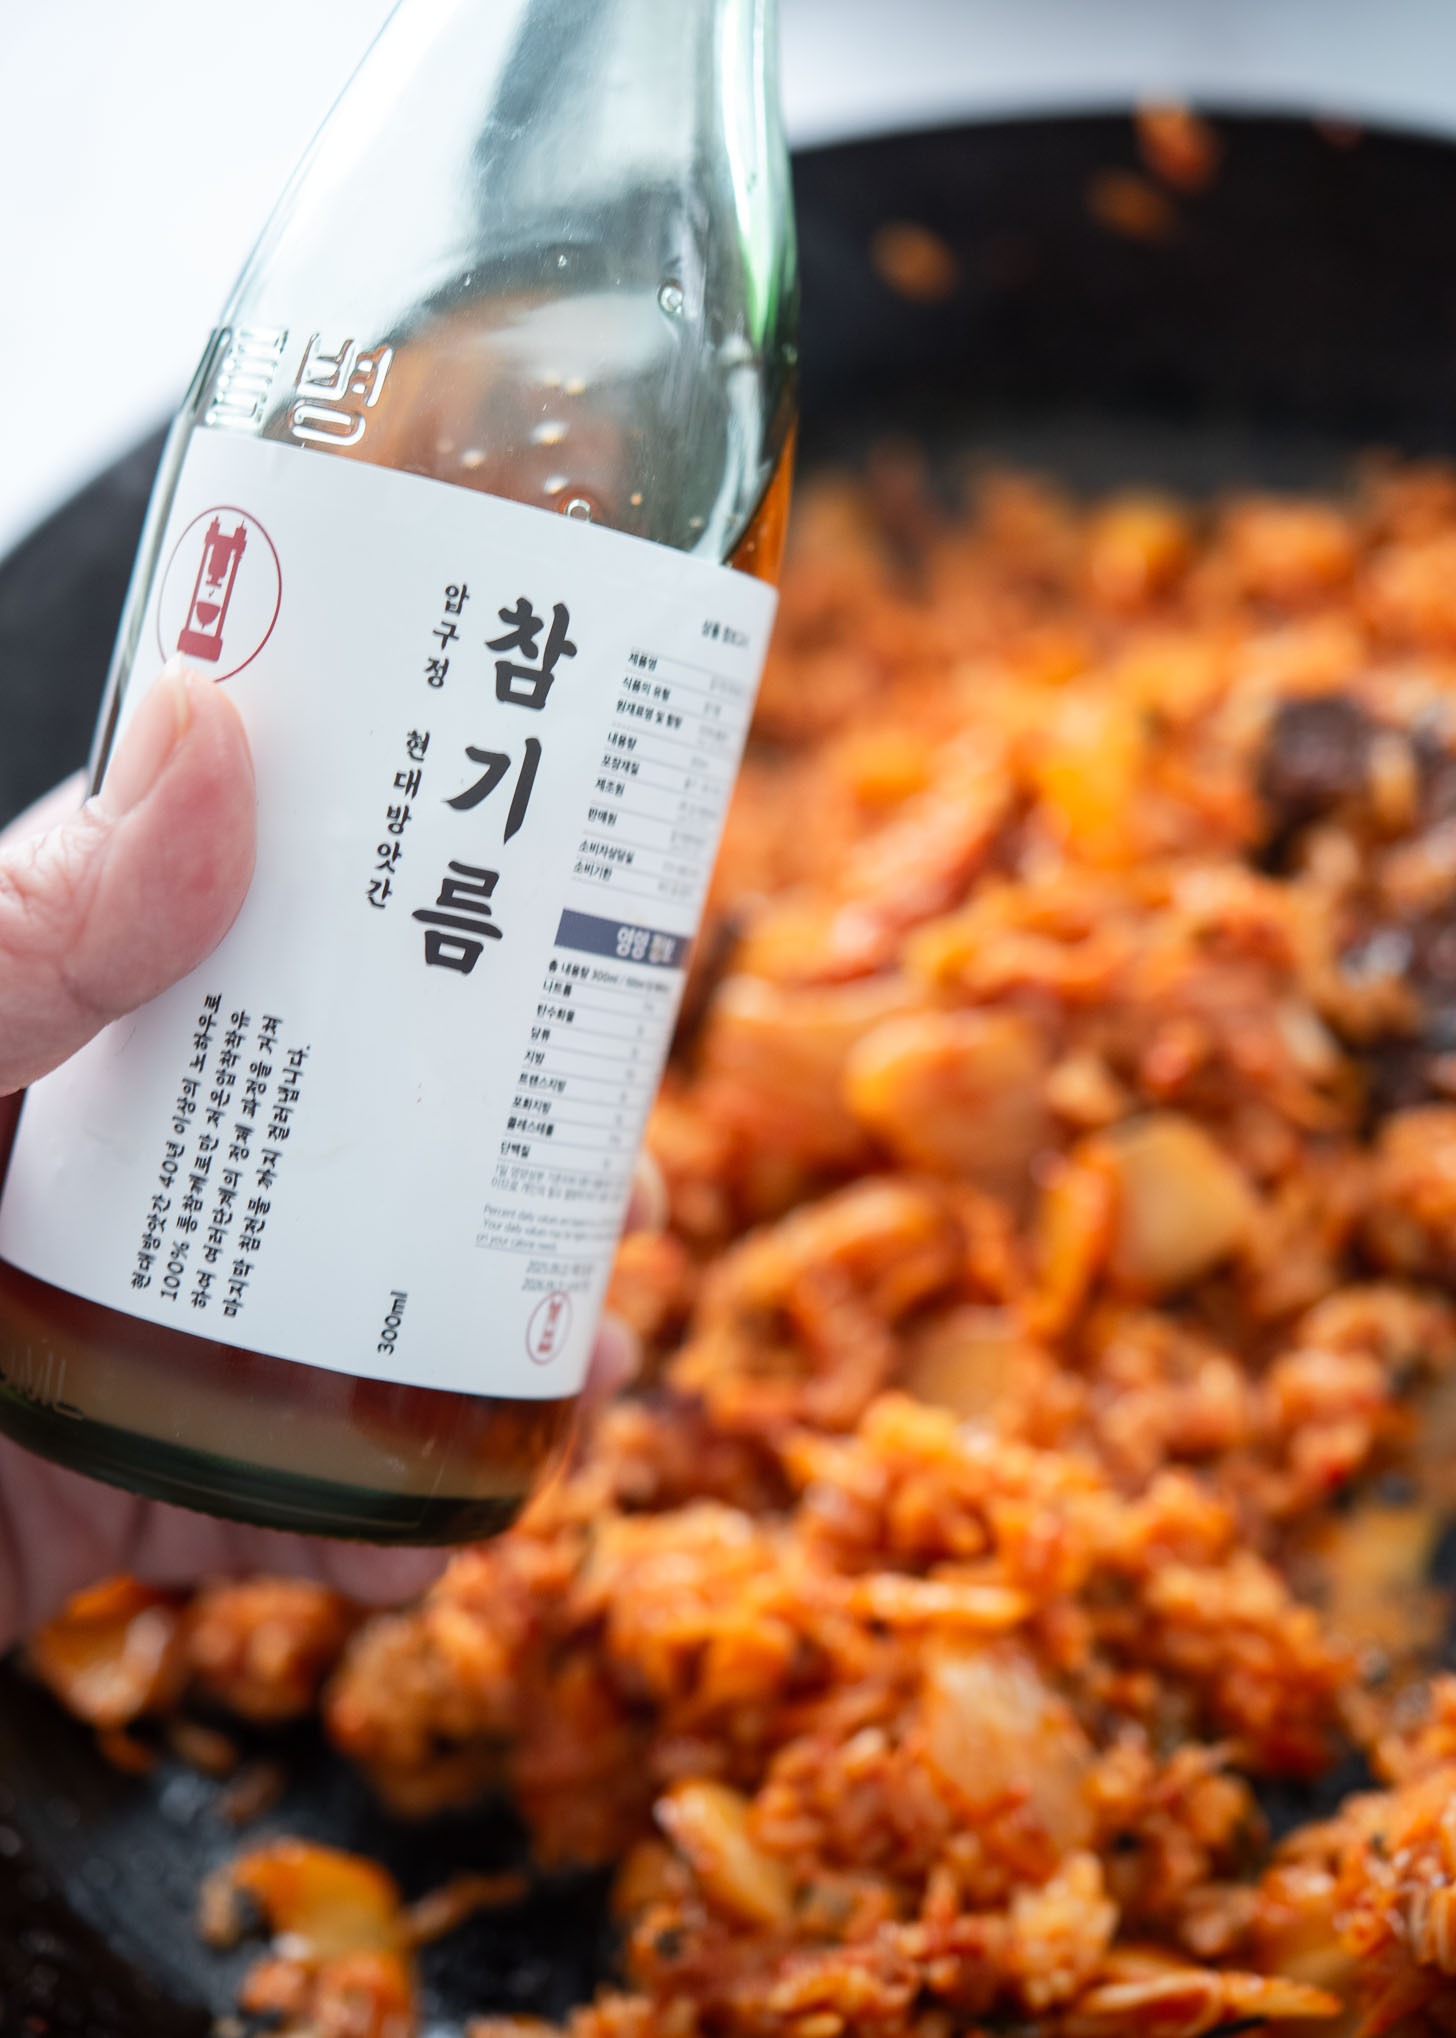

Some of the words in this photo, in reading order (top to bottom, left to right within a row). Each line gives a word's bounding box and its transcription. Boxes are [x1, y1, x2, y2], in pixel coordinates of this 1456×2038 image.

[423, 582, 470, 689] 압구정
[628, 652, 657, 672] 제품명
[623, 676, 651, 695] 식품의
[653, 686, 670, 701] 유형
[616, 699, 654, 721] 원재료명
[608, 731, 637, 750] 내용량
[602, 754, 640, 776] 포장재질
[411, 596, 577, 976] 참기름
[595, 777, 625, 797] 제조원
[366, 728, 430, 909] 현대방앗간
[588, 807, 617, 826] 판매원
[573, 861, 612, 881] 소비기한
[616, 926, 649, 960] 영양
[543, 979, 572, 997] 나트륨
[561, 963, 590, 979] 내용량
[537, 1003, 575, 1023] 탄수화물
[258, 1015, 283, 1054] 거쳐
[531, 1026, 550, 1041] 당류
[524, 1050, 545, 1065] 지방
[241, 1061, 272, 1118] 과정을
[267, 1045, 311, 1141] 걸러냅니다.
[512, 1096, 552, 1115] 포화지방
[131, 1194, 171, 1289] 현대방앗간
[159, 1141, 185, 1189] 40년
[172, 1078, 201, 1134] 이상의
[190, 993, 222, 1073] 노하우로
[161, 1240, 189, 1301] 100%
[176, 1134, 219, 1233] 통참깨로만
[205, 1010, 250, 1128] 저온압착착유
[229, 1124, 254, 1162] 정제
[501, 1141, 530, 1158] 단백질
[256, 1149, 282, 1190] 까지
[203, 1169, 242, 1263] 여러단계의
[238, 1197, 271, 1252] 침전물
[191, 1270, 215, 1308] 하여
[223, 1259, 254, 1317] 마지막
[378, 1290, 408, 1355] 300ml
